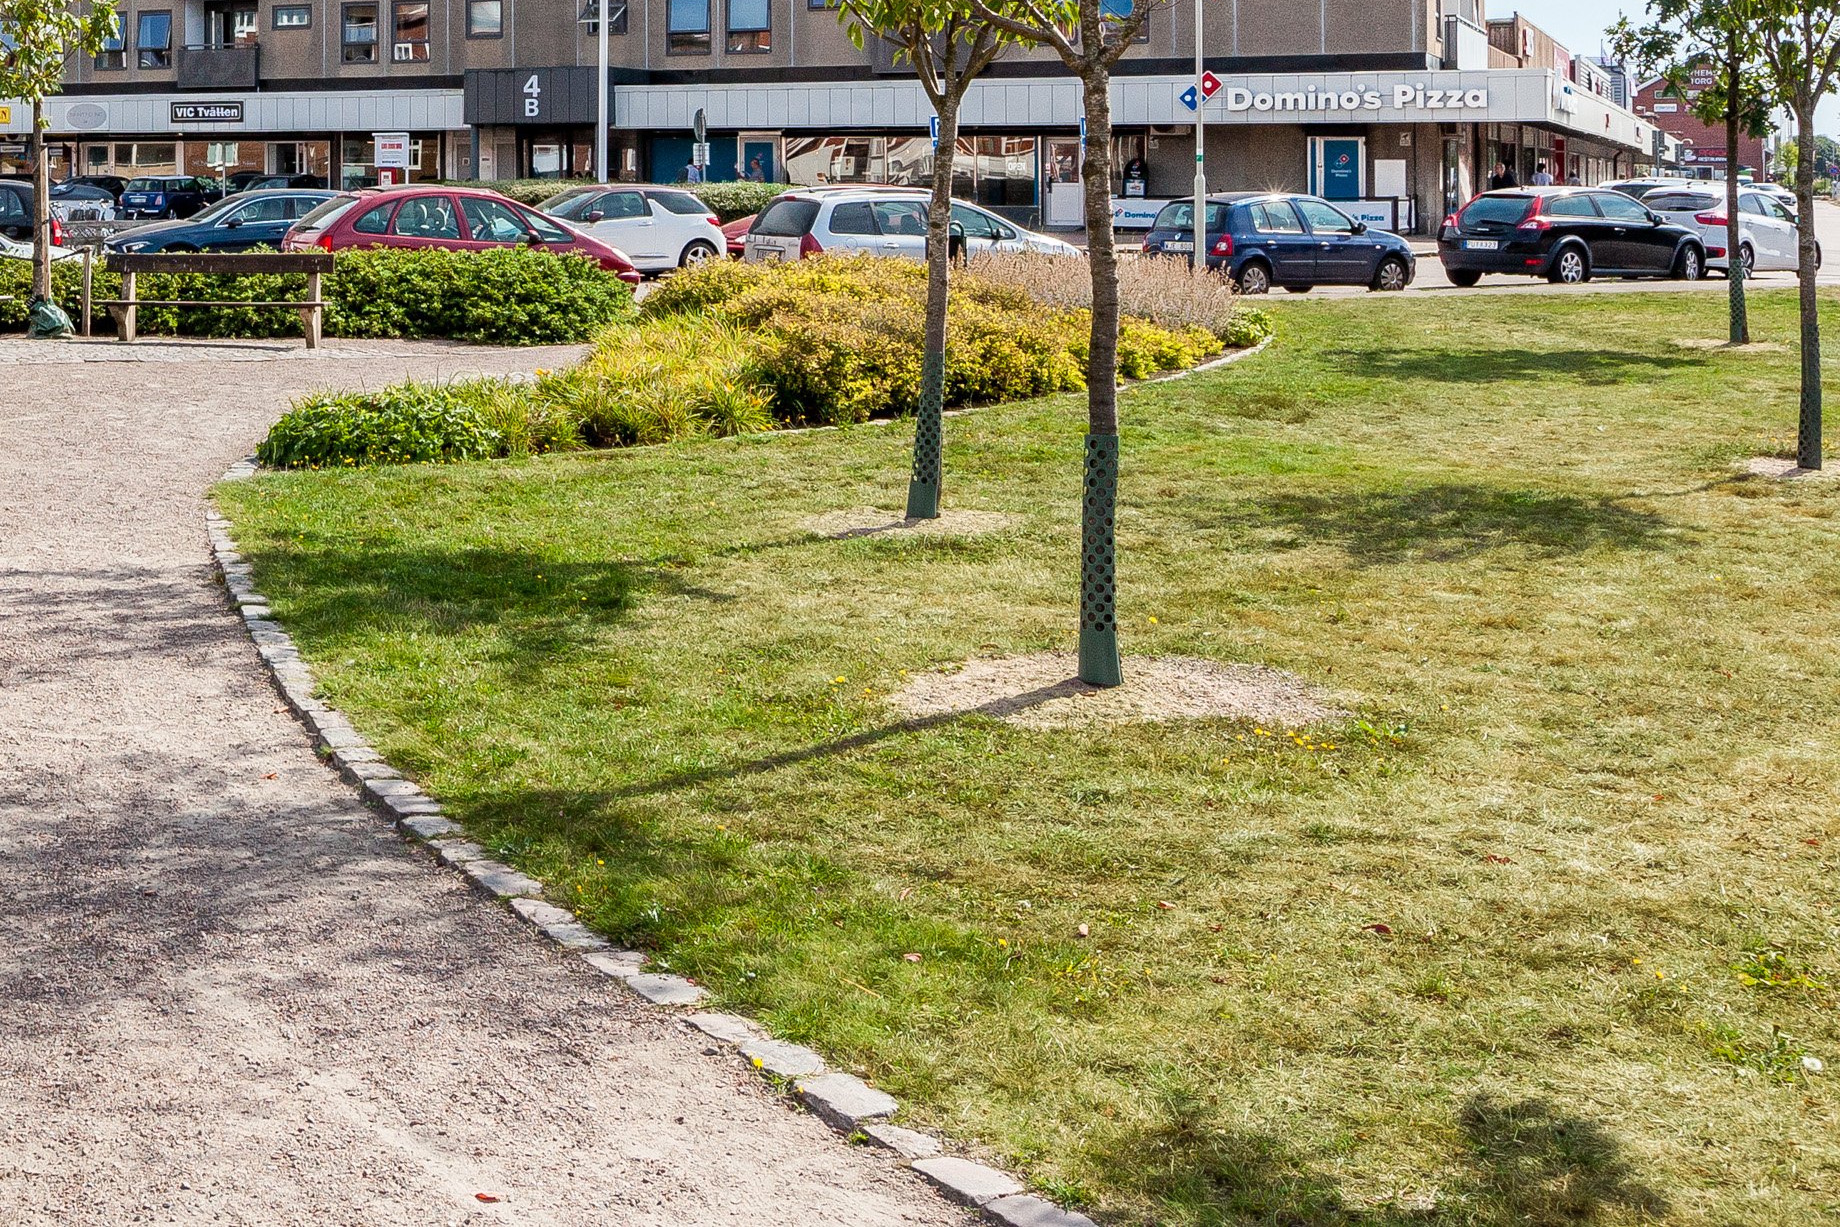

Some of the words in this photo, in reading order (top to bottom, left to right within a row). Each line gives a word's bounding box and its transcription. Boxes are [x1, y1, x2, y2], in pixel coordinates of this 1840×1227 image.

[523, 74, 541, 98] 4
[1226, 84, 1383, 111] Domino's
[1393, 82, 1488, 109] Pizza
[175, 107, 195, 118] VIC
[525, 98, 539, 117] B
[1361, 214, 1384, 222] Pizza
